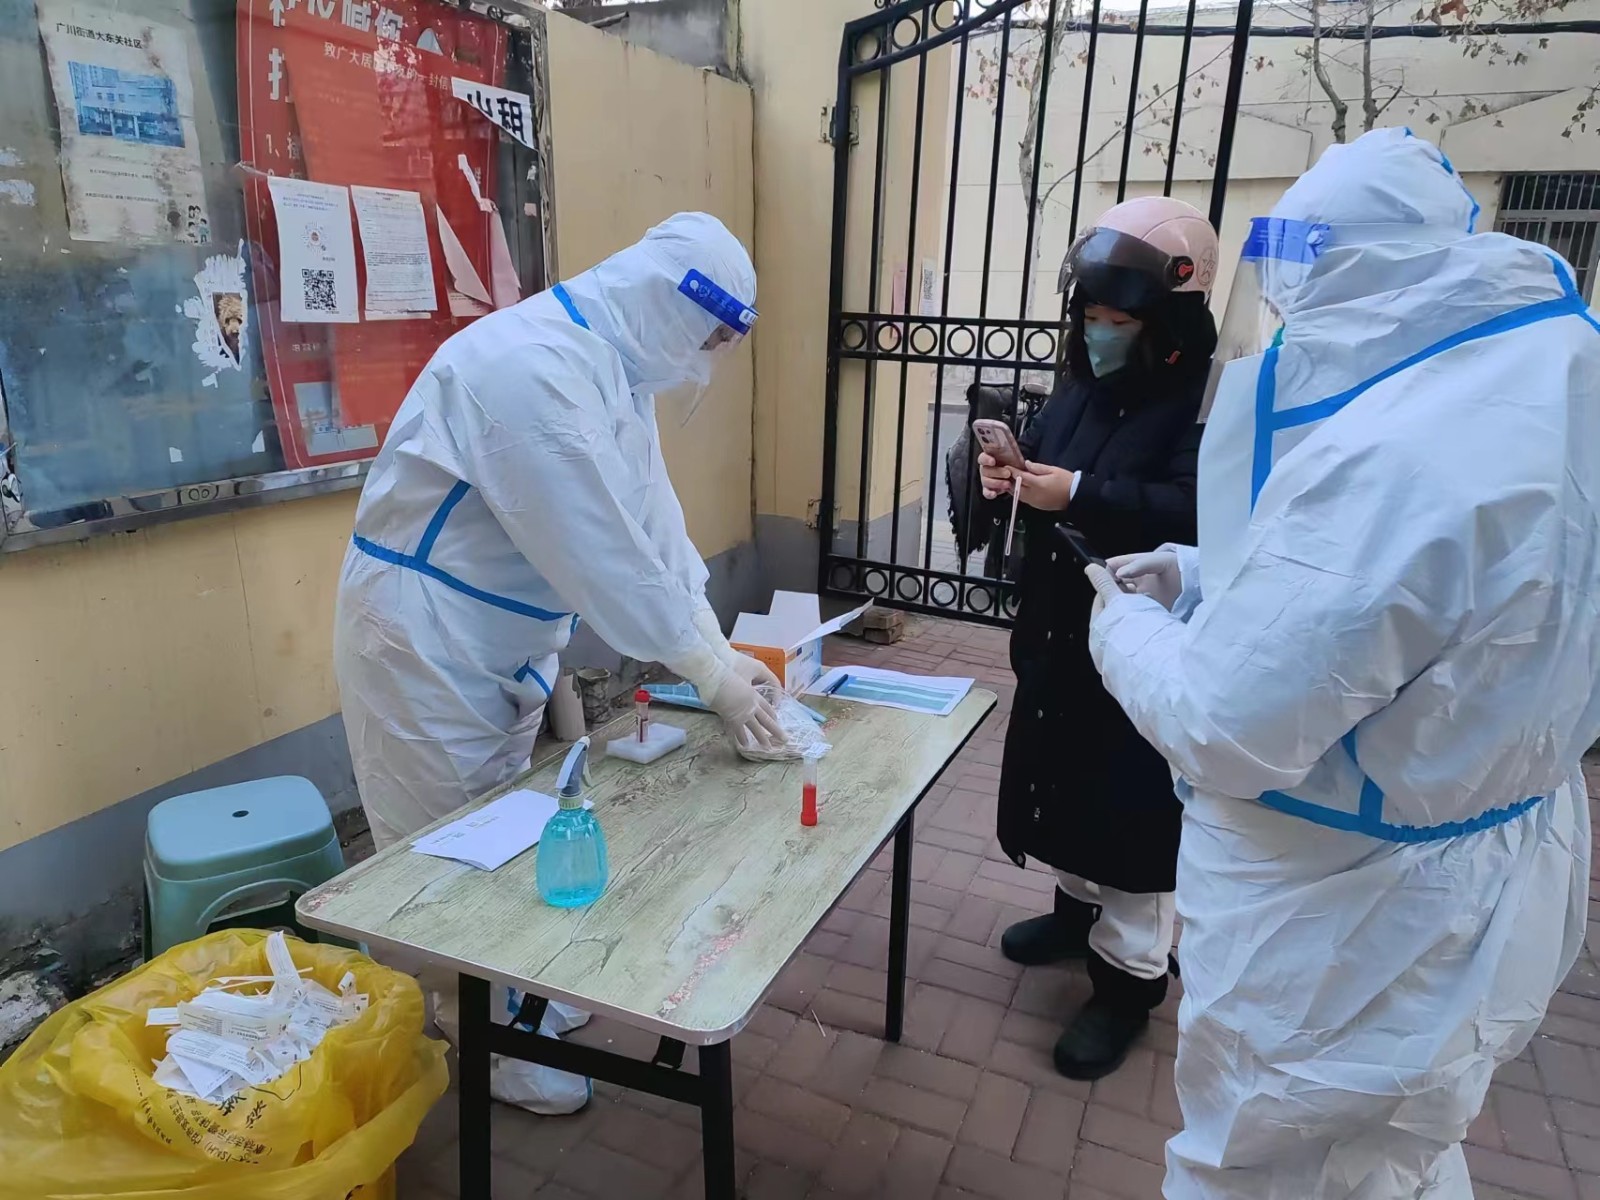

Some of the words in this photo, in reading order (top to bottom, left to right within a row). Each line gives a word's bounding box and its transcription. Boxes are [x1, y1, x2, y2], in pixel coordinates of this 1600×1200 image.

[56, 22, 143, 49] 广川街道大东关社区
